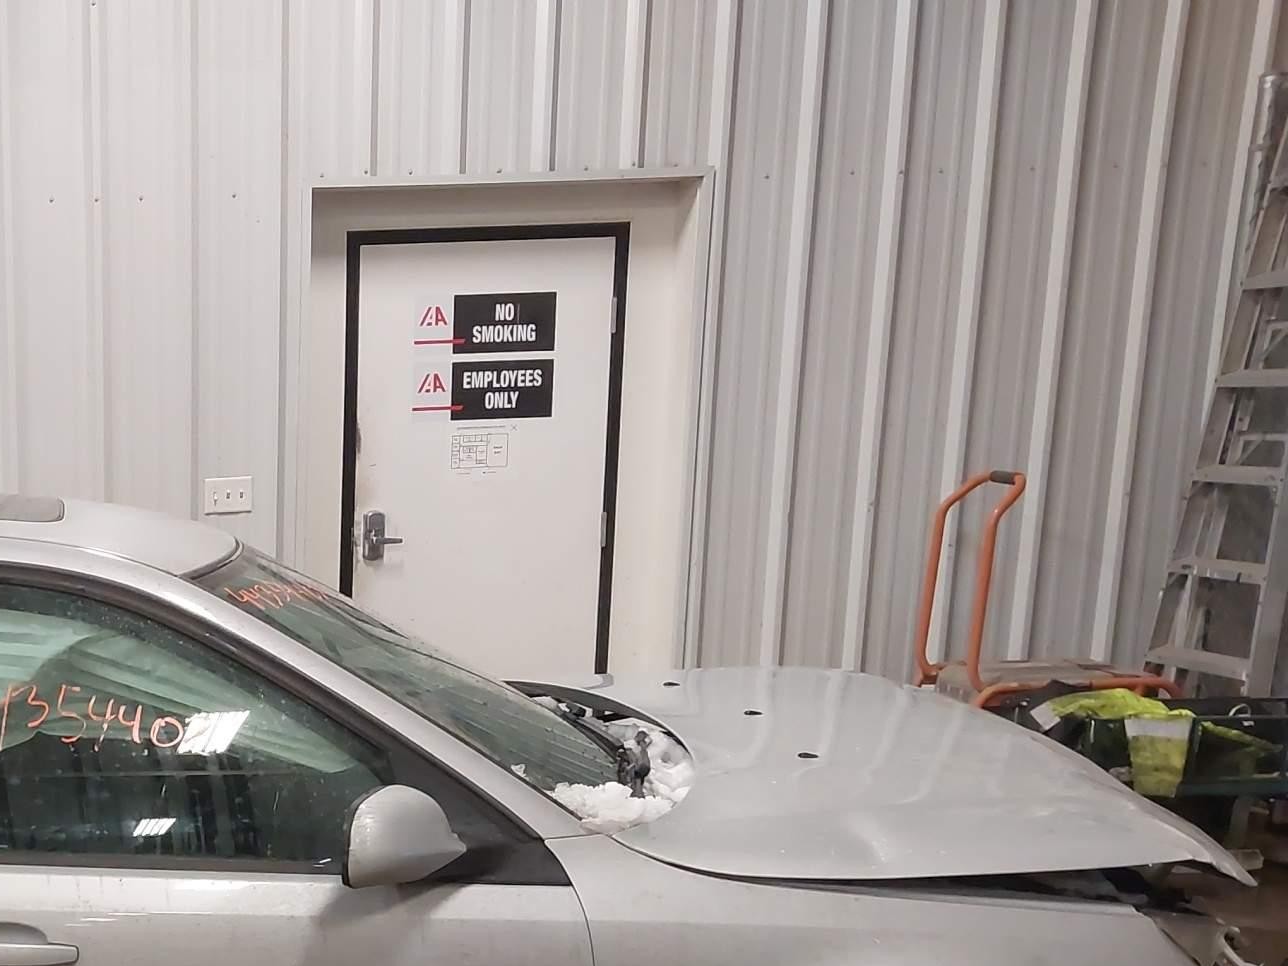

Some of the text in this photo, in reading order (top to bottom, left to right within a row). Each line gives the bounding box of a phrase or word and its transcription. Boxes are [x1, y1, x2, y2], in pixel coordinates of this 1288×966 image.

[495, 303, 515, 321] NO
[472, 324, 537, 343] SMOKING
[462, 369, 543, 389] EMPLOYEES
[484, 391, 519, 410] ONLY
